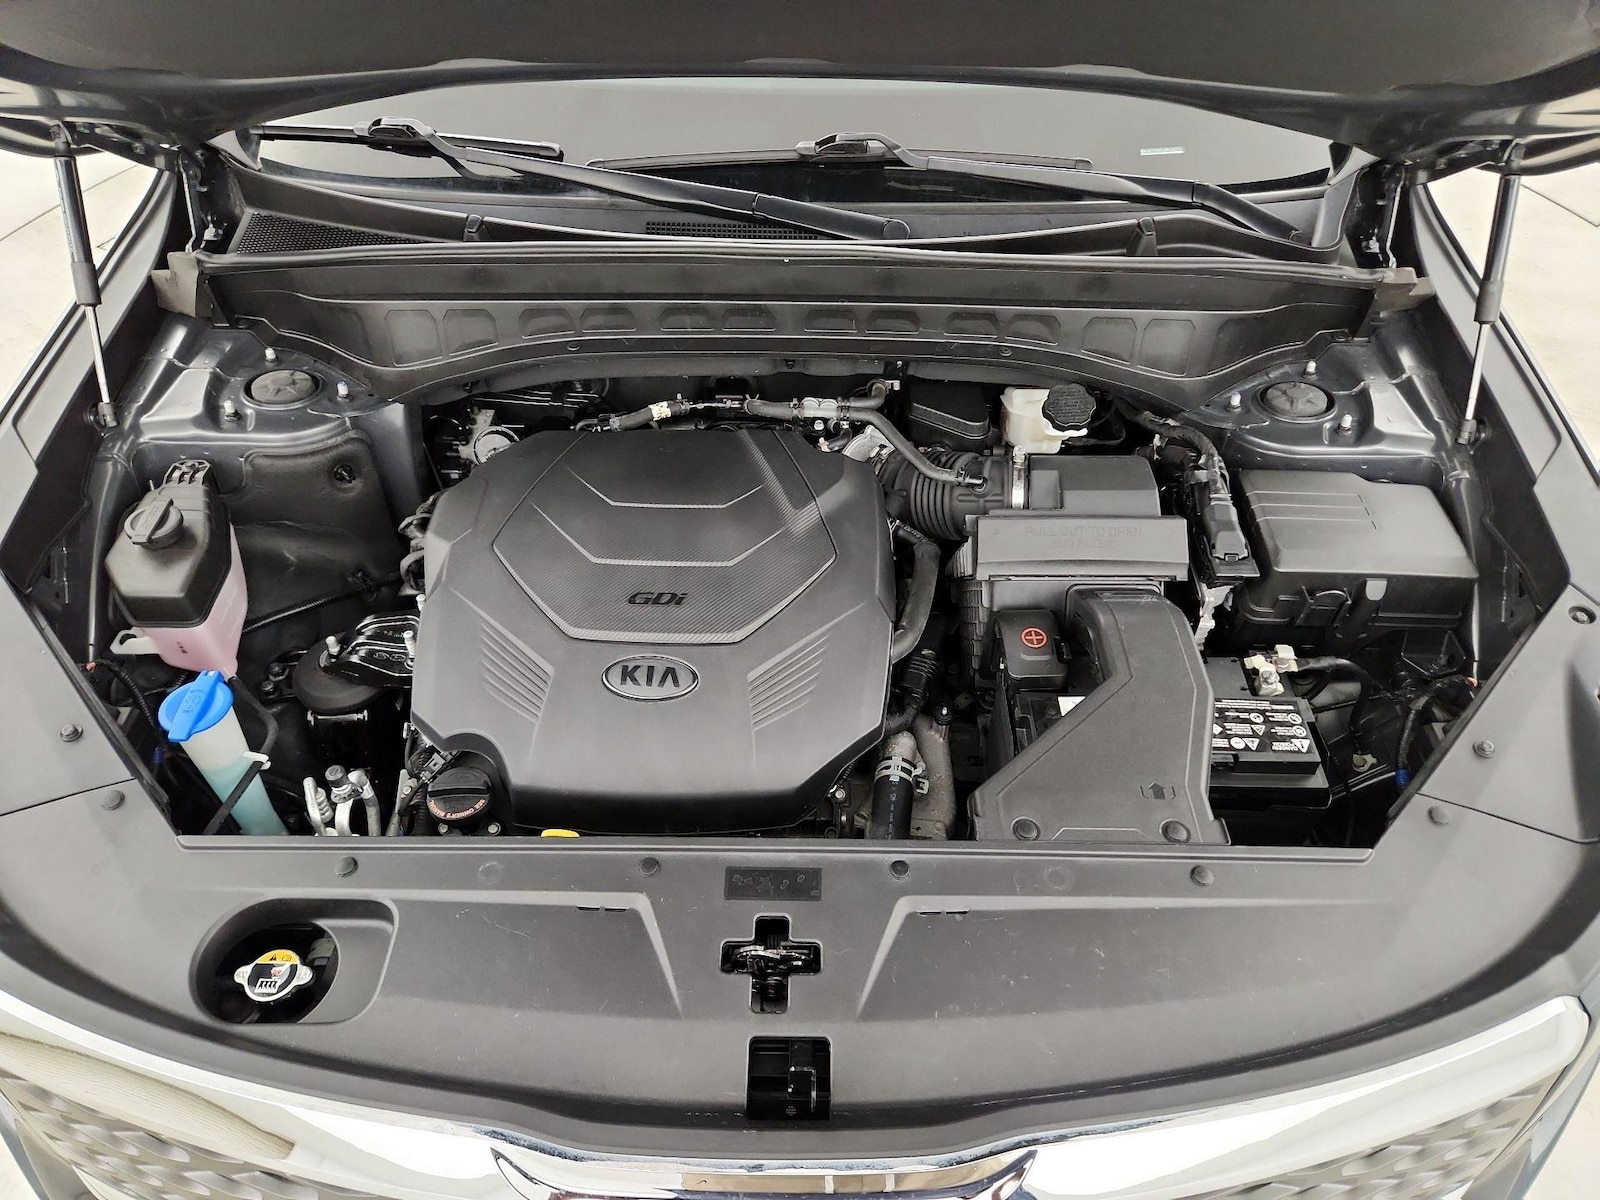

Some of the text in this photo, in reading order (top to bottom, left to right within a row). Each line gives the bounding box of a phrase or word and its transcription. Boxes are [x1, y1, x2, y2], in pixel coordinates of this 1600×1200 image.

[1025, 526, 1142, 537] PULL OUT TO OPEN
[628, 592, 688, 606] GDi
[620, 664, 680, 688] KIA
